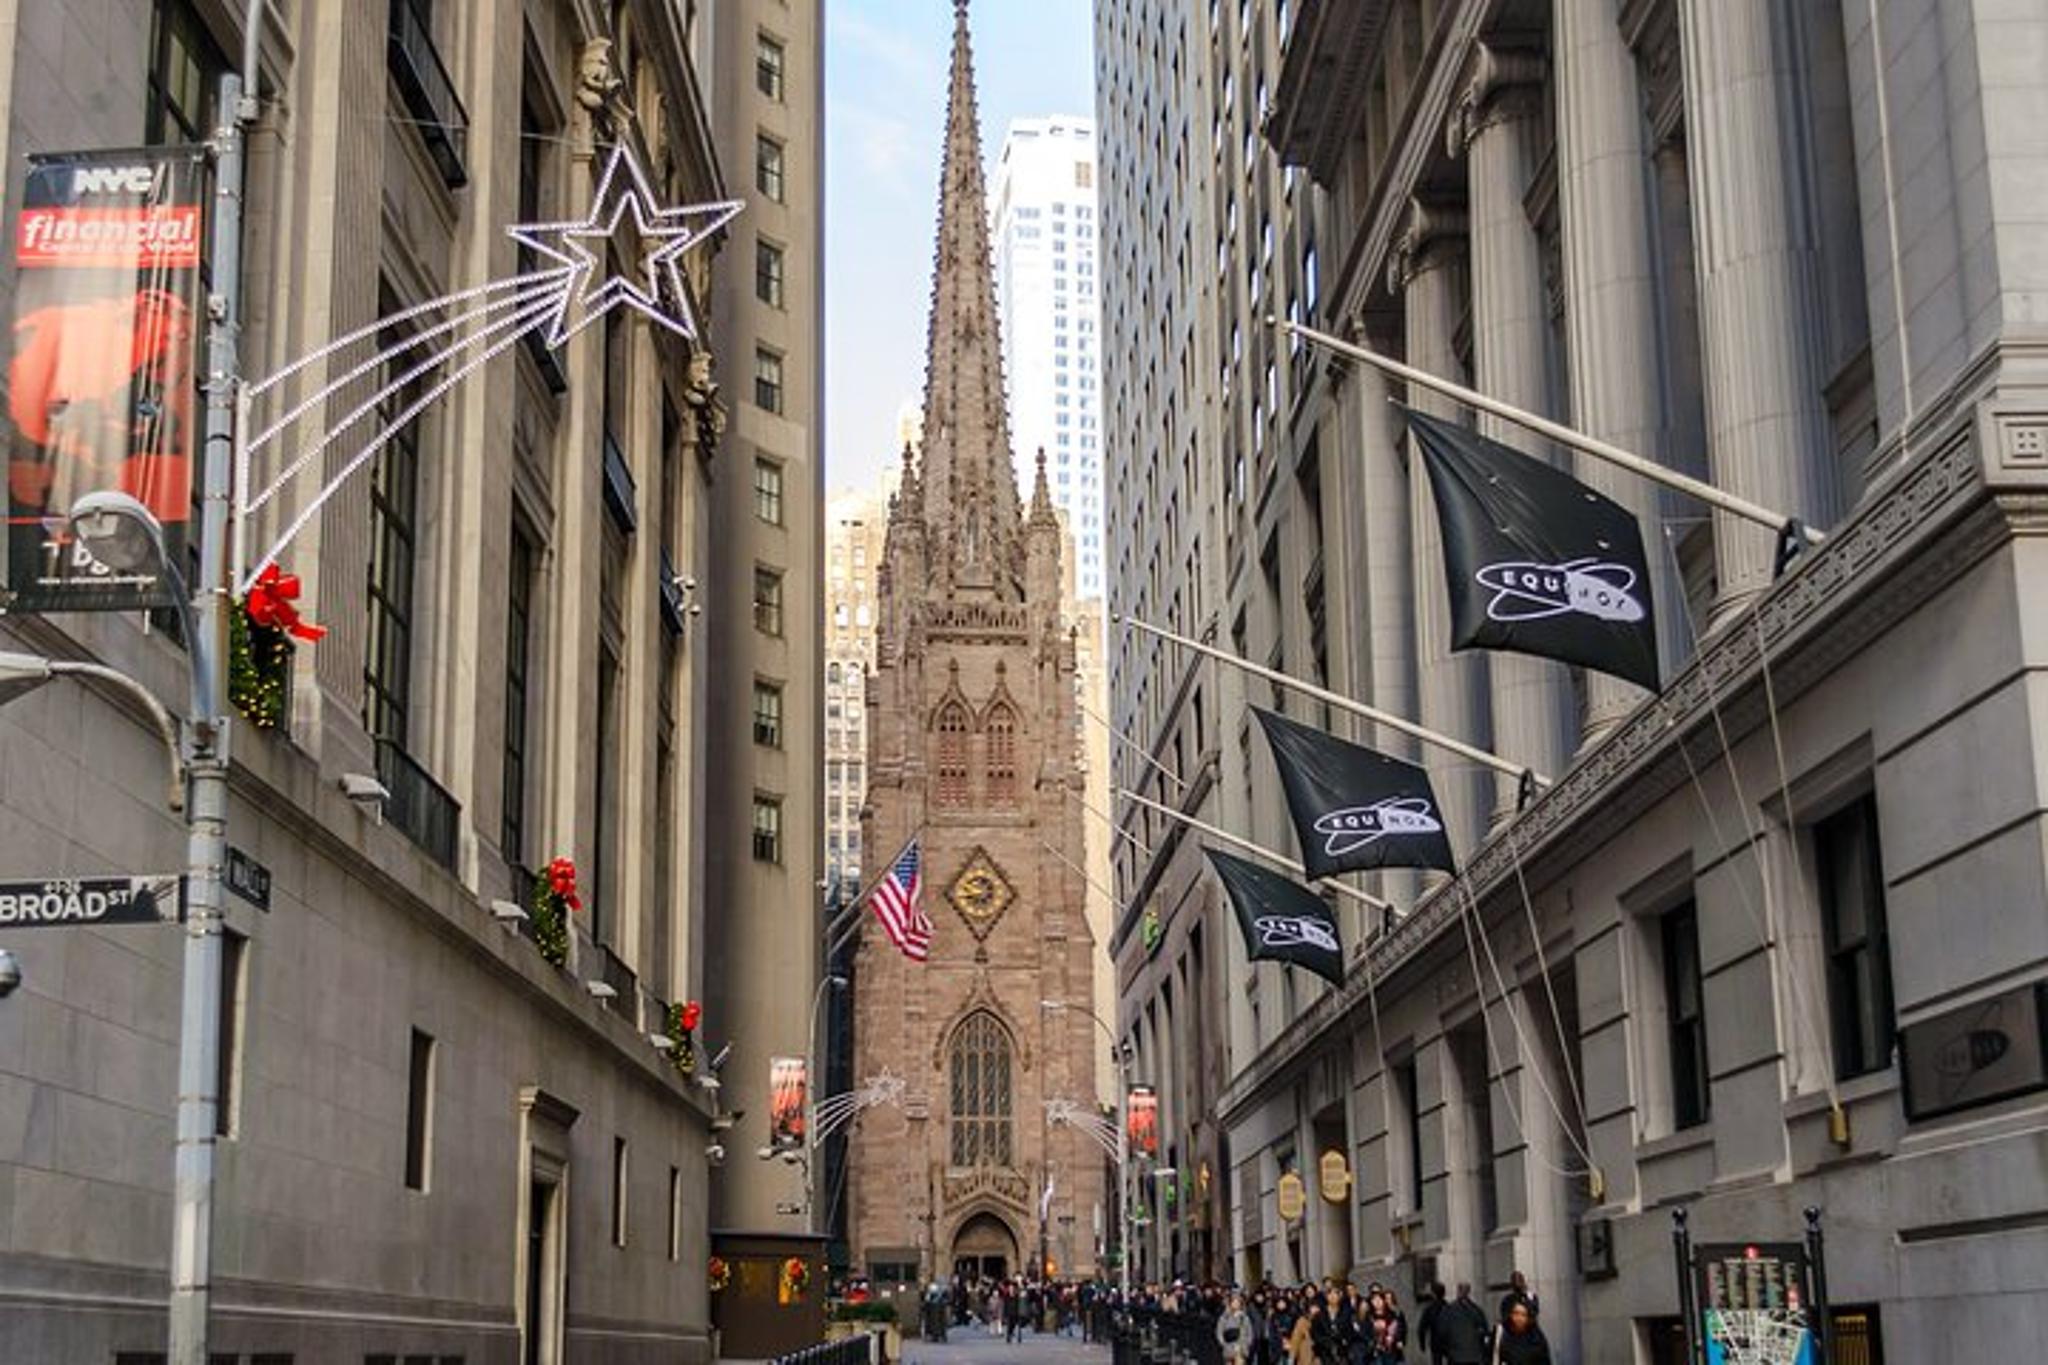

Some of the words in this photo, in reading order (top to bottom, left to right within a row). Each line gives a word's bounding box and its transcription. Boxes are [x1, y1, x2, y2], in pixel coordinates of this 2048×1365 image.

[75, 166, 153, 192] NYC
[24, 213, 196, 248] financial
[0, 892, 107, 920] BROAD
[107, 889, 130, 905] ST
